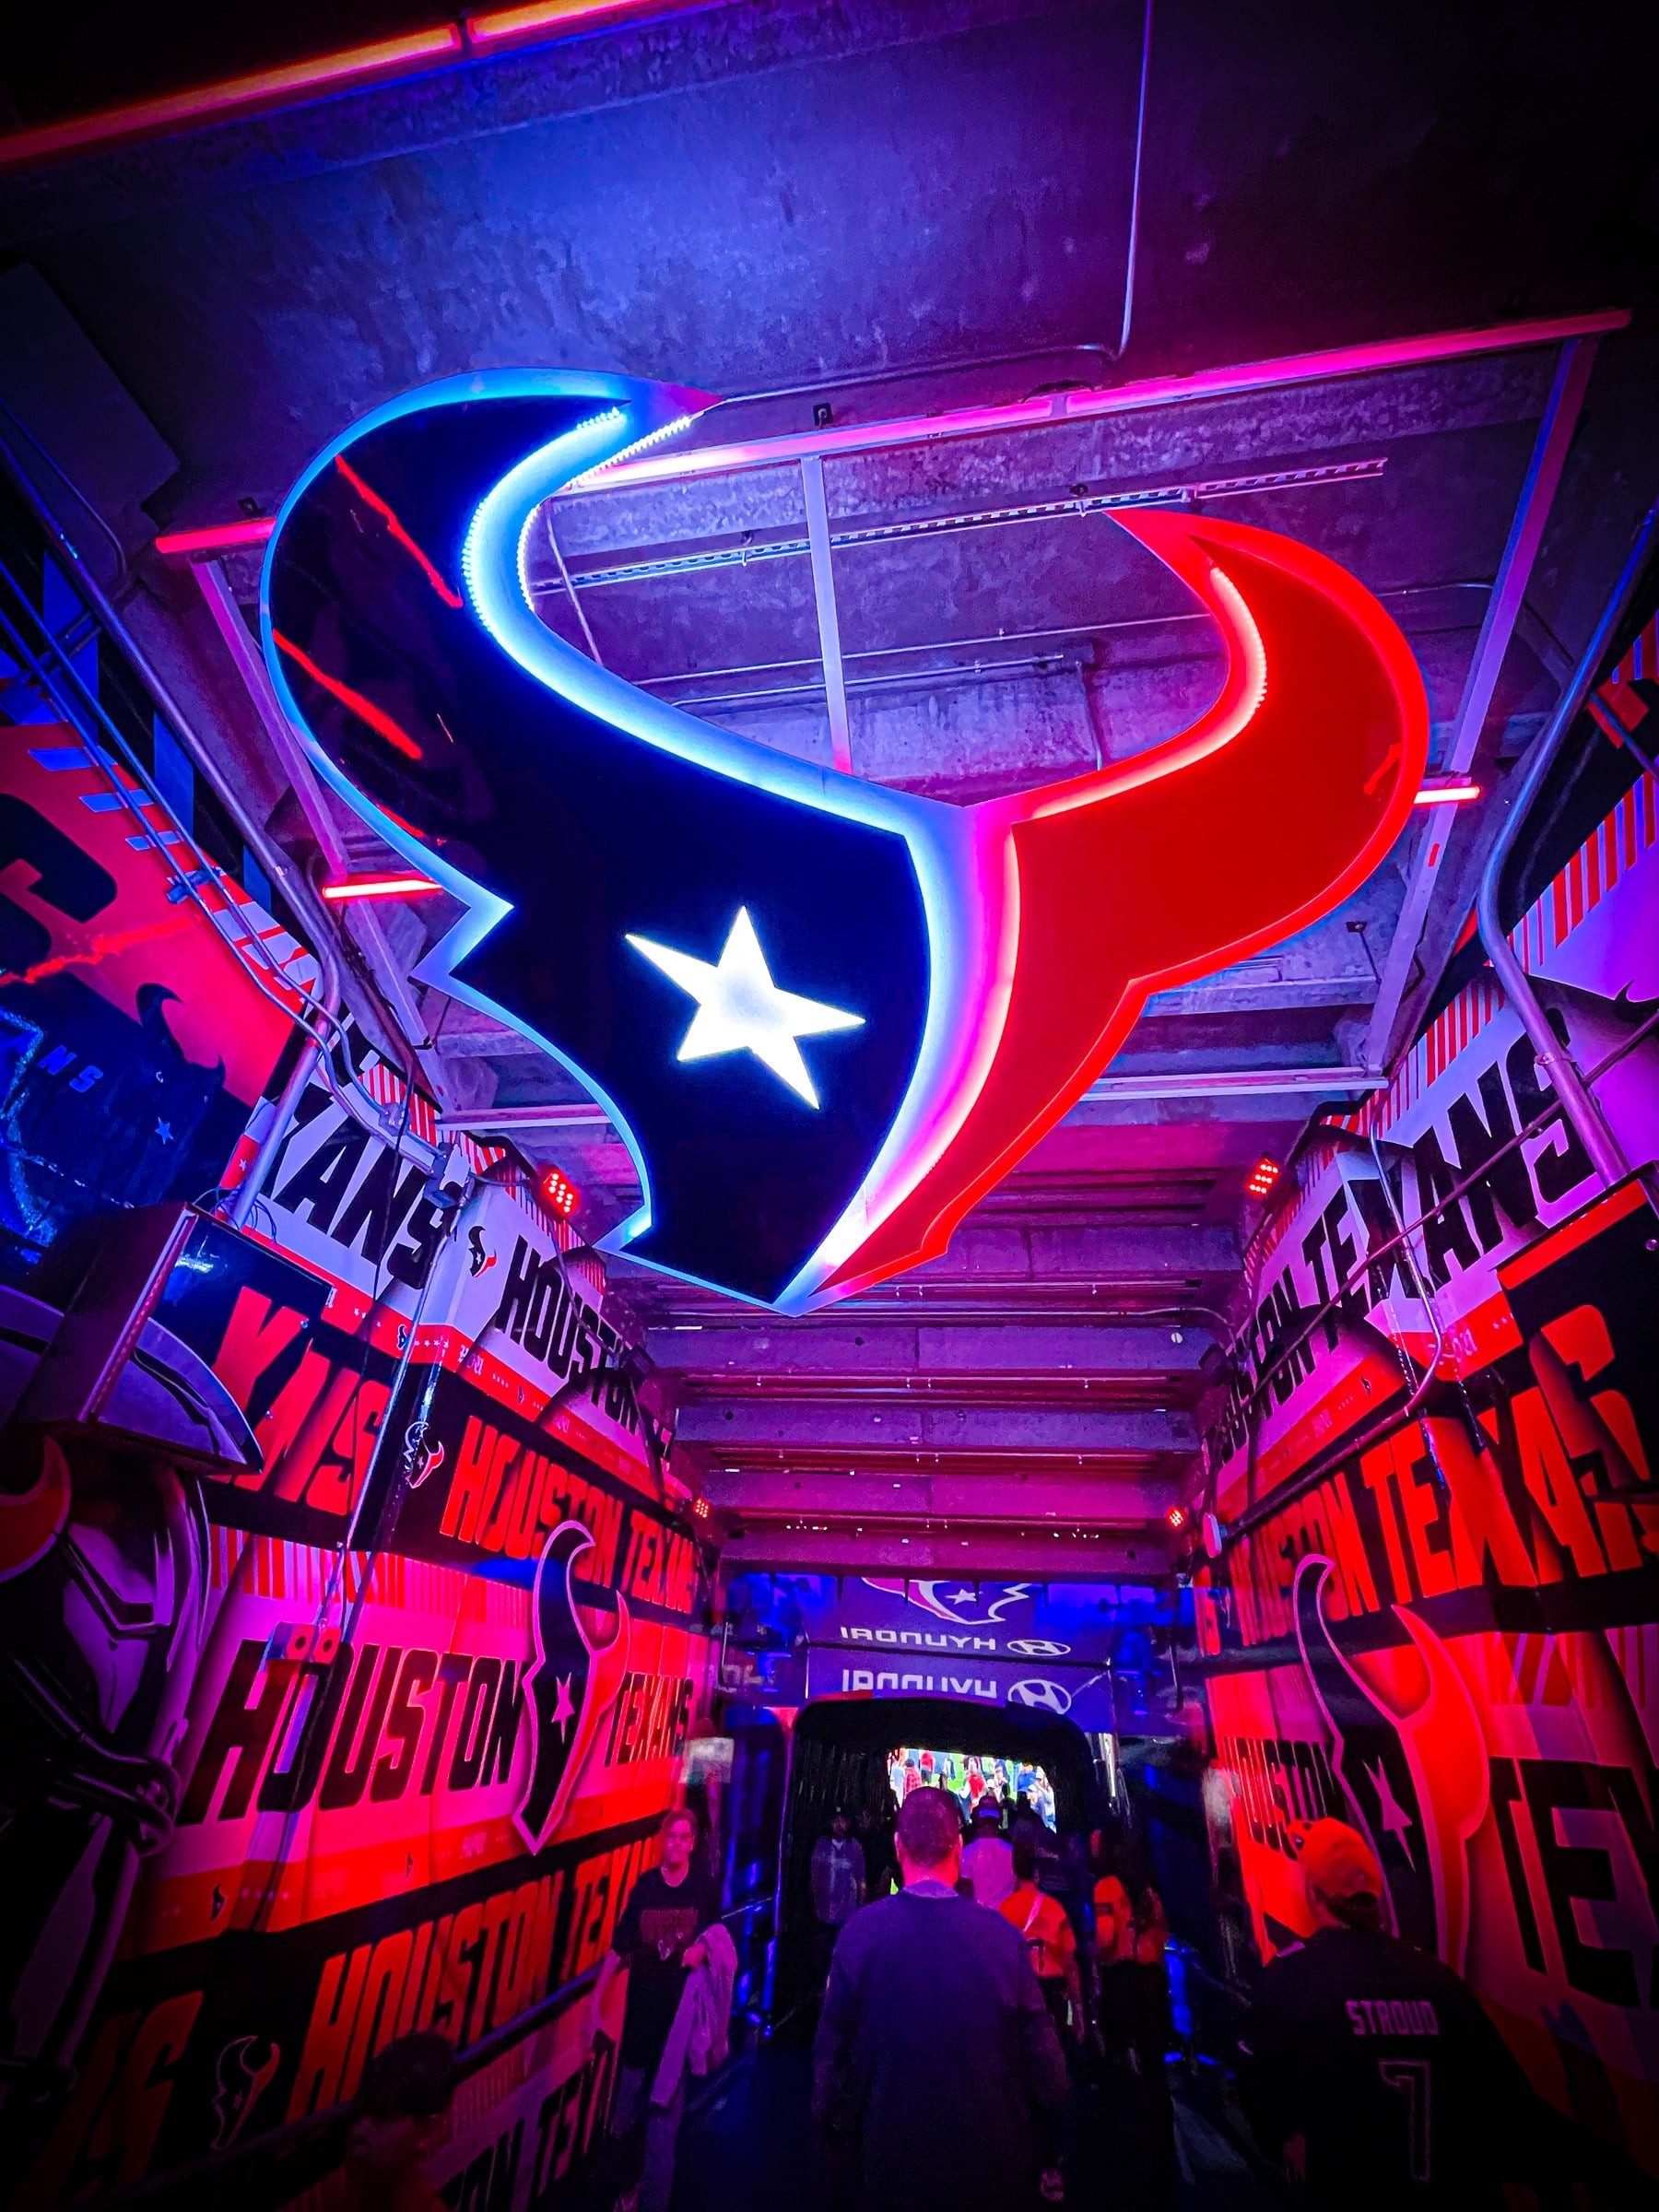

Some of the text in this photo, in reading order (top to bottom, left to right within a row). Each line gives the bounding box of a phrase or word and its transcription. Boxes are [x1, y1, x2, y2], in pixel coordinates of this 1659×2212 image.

[440, 1415, 624, 1588] HOUSTON
[174, 1638, 528, 1828] HOUSTON
[286, 1869, 566, 2124] HOUSTON
[1345, 1999, 1440, 2036] STROUD
[1377, 2058, 1432, 2184] 7
